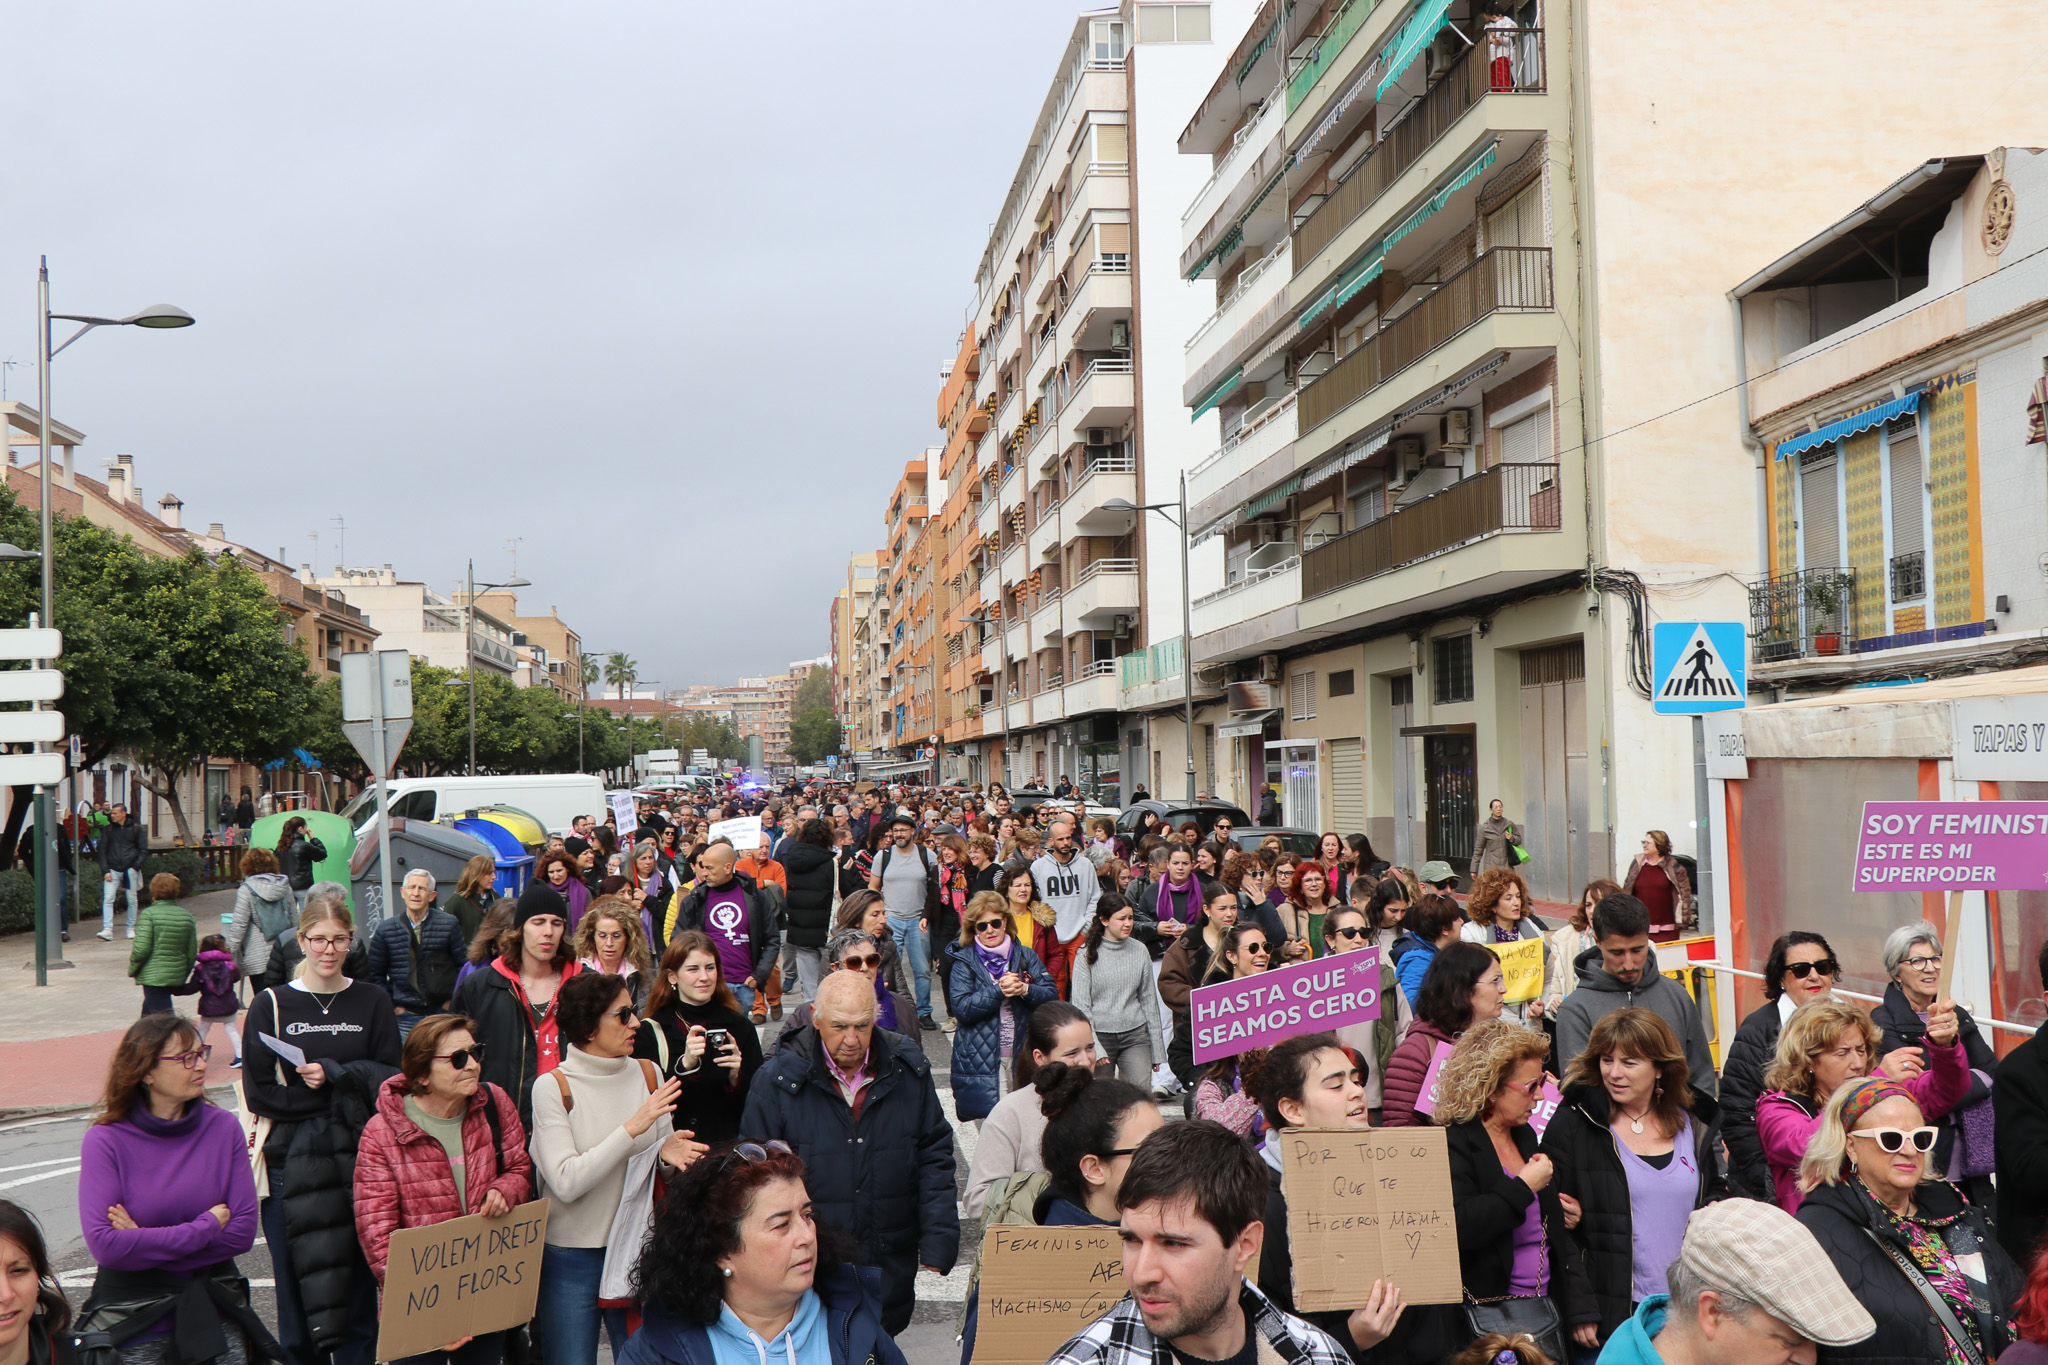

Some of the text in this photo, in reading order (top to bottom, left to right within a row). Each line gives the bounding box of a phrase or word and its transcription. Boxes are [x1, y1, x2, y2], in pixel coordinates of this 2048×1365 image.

[1973, 722, 2046, 753] TAPAS Y
[1866, 814, 2048, 836] SOY FEMINIST
[1863, 843, 1973, 861] ESTE ES MI
[1860, 866, 1997, 884] SUPERPODER
[1501, 944, 1537, 961] LA VOZ
[1508, 968, 1520, 982] NO
[1197, 968, 1346, 1023] HASTA QUE
[286, 1022, 364, 1036] Champion
[1198, 987, 1377, 1049] SEAMOS CERO
[1294, 1140, 1337, 1168] POR
[1354, 1143, 1399, 1163] TODO
[1333, 1176, 1398, 1198] QUE TE
[411, 1219, 542, 1276] VOLEM DRETS
[995, 1230, 1110, 1254] FEMINISMO
[407, 1261, 526, 1316] NO FLORS
[991, 1296, 1072, 1318] MACHISMO
